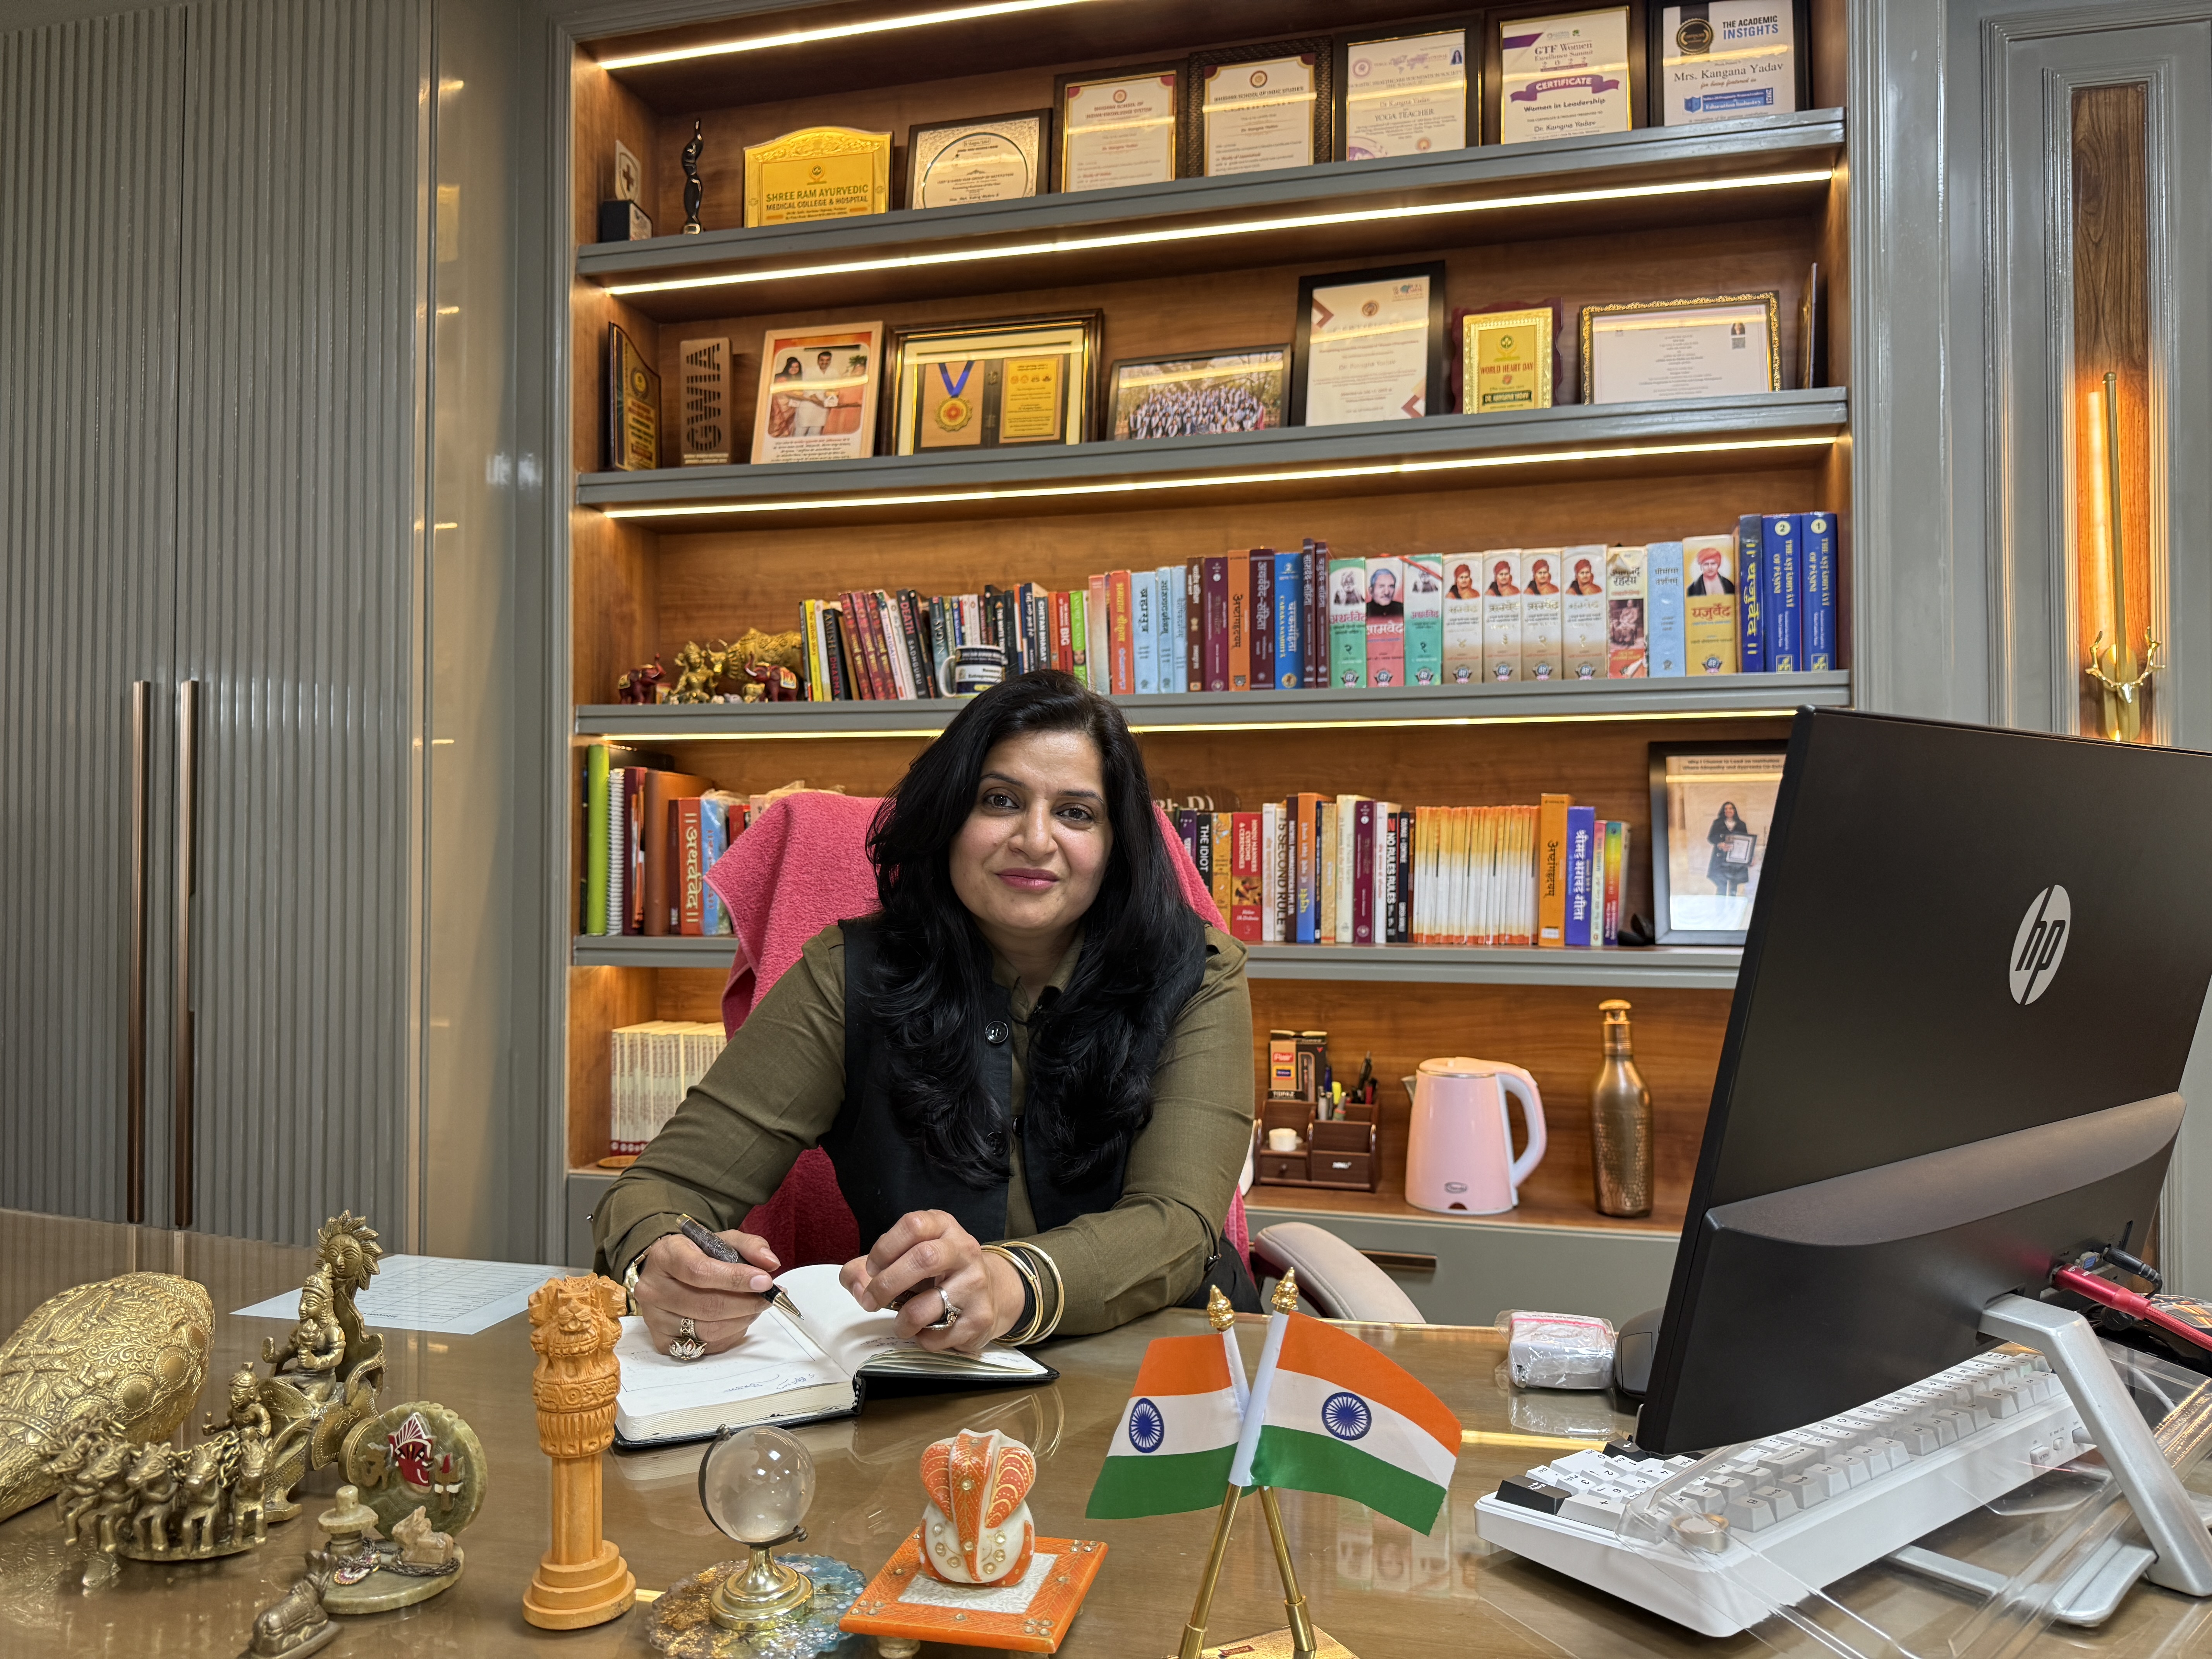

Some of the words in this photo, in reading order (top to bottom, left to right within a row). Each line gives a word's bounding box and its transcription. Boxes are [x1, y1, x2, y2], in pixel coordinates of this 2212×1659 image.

[1738, 15, 1778, 26] ACADEMIC
[1723, 24, 1779, 40] INSIGHTS
[1560, 42, 1592, 51] Women
[1674, 72, 1698, 82] Mrs.
[1701, 67, 1747, 79] Kangana
[1750, 63, 1784, 73] Yadav
[1536, 77, 1592, 91] CERTIFICATE
[766, 191, 795, 202] SHREE
[797, 189, 816, 199] RAM
[819, 184, 869, 197] AYURVEDIC
[797, 200, 827, 208] COLLEGE
[835, 196, 868, 204] HOSPITAL
[1480, 365, 1500, 374] WORLD
[1503, 363, 1520, 373] HEART
[1523, 362, 1533, 371] DAY
[1779, 524, 1785, 532] 2
[1816, 522, 1821, 531] 1
[900, 601, 915, 635] DEATH
[824, 614, 836, 649] AMISH
[1060, 627, 1070, 646] BIG
[908, 640, 922, 685] SADHGURU
[830, 657, 840, 696] DHARMA
[1200, 824, 1209, 844] THE
[1387, 832, 1396, 845] NO
[1200, 846, 1209, 872] IDIOT
[1278, 834, 1287, 888] SECOND
[1387, 847, 1396, 874] RULES
[1387, 876, 1396, 903] RULES
[1277, 892, 1286, 925] RULE
[2015, 884, 2066, 1005] hp
